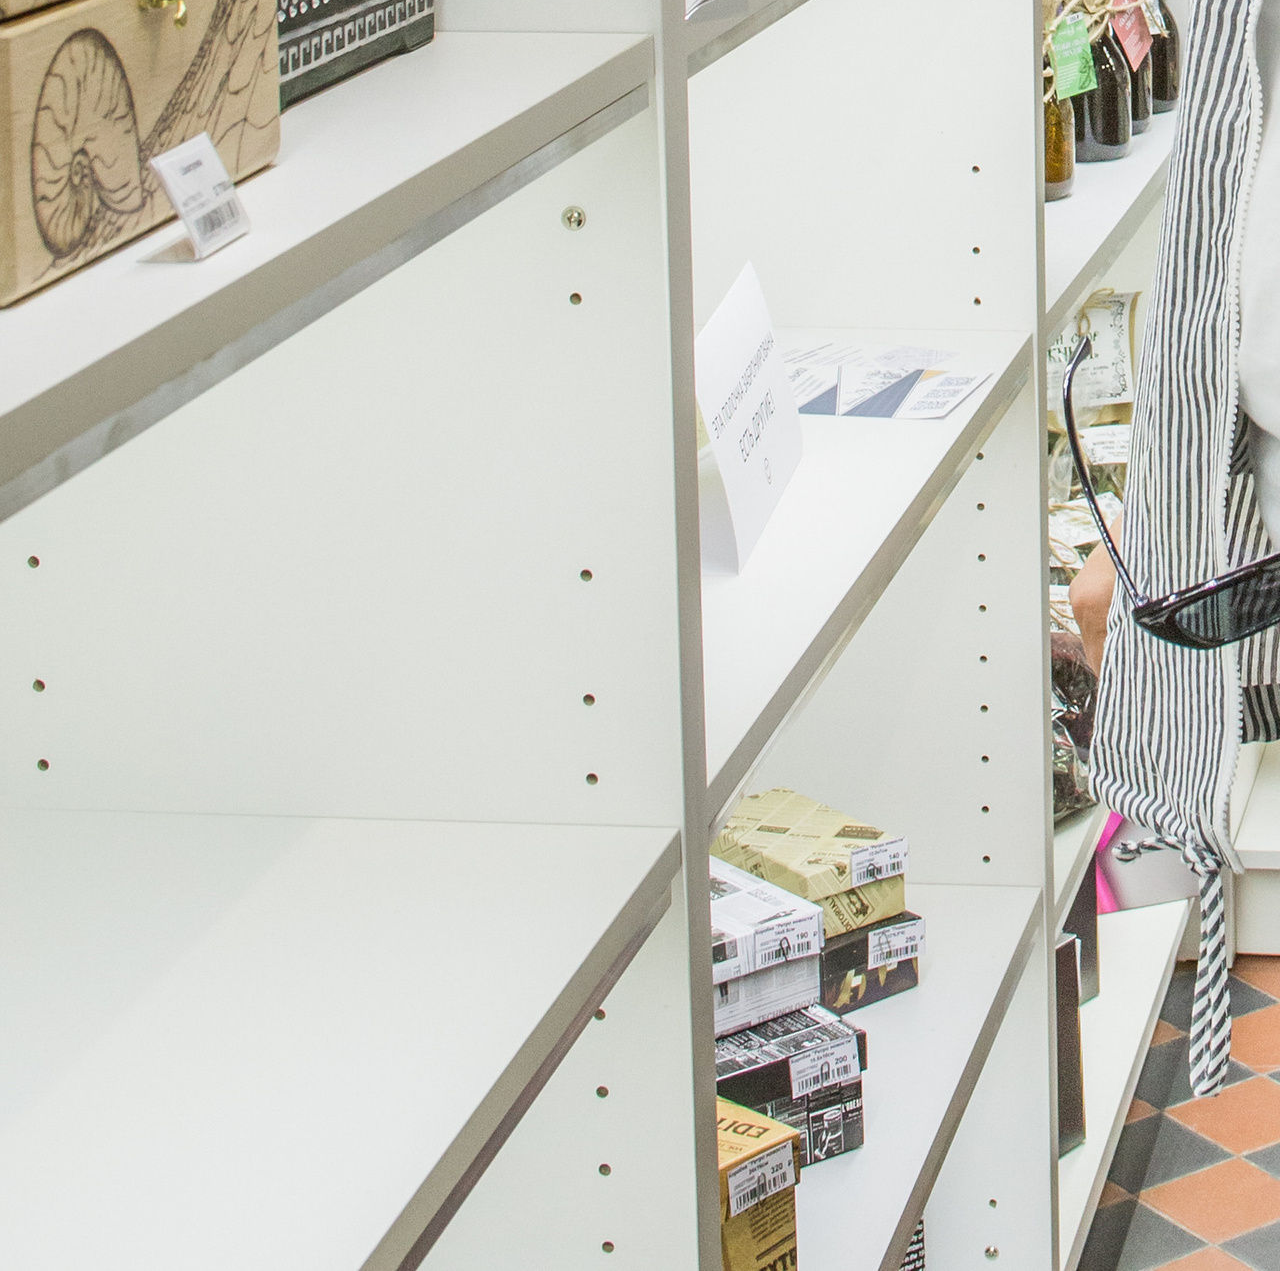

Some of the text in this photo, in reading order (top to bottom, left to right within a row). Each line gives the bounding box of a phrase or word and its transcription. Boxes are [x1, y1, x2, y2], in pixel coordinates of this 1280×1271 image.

[826, 896, 853, 931] DITORIAL
[796, 931, 809, 940] 190
[905, 935, 917, 943] 250
[834, 1055, 848, 1065] 200
[770, 1162, 783, 1174] 320
